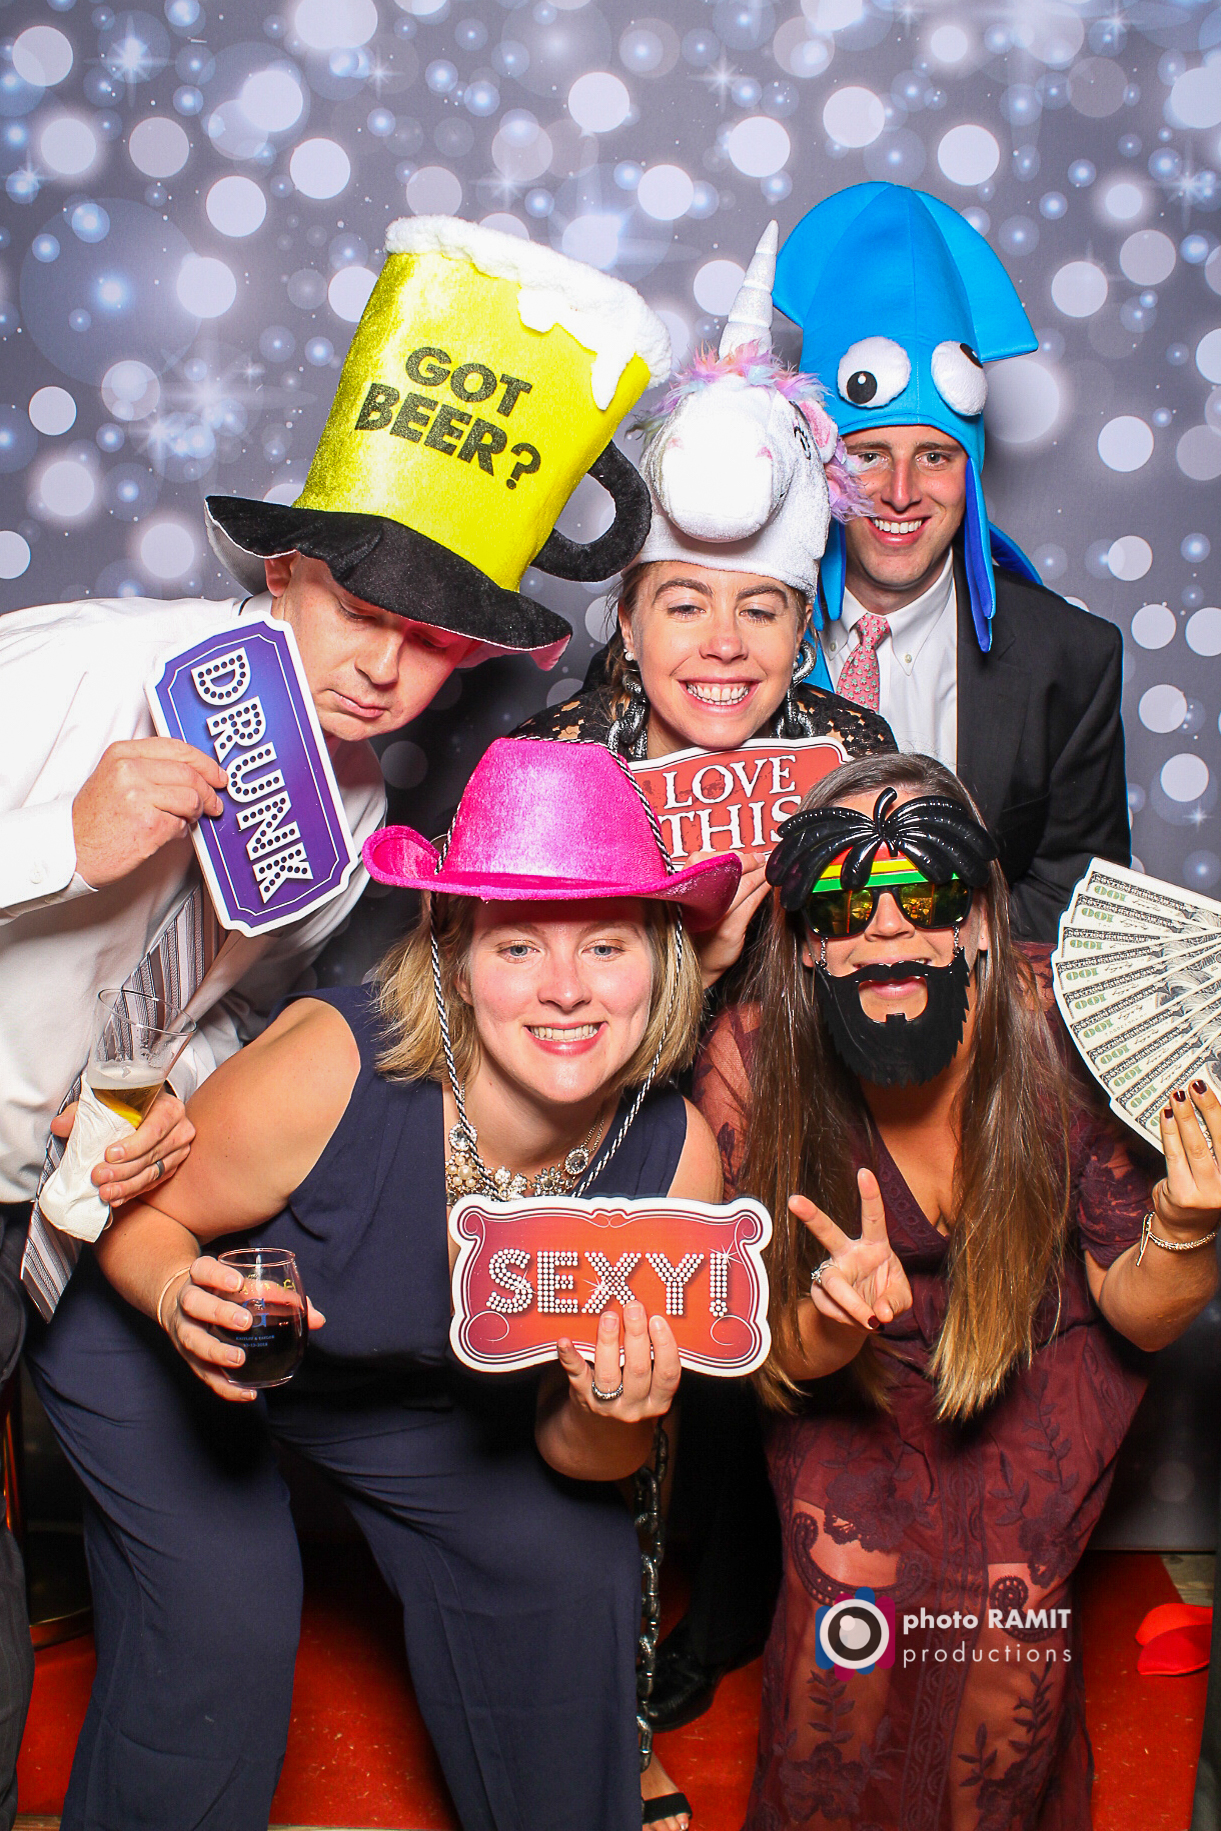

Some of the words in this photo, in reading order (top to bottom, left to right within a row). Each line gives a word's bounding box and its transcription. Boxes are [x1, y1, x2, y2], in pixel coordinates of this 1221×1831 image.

[405, 346, 533, 418] GOT
[354, 382, 542, 490] BEER?
[190, 647, 314, 904] DRUNK
[662, 755, 797, 809] LOVE
[1094, 886, 1127, 902] 100
[1081, 908, 1114, 922] 100
[1069, 939, 1103, 950] 100
[1066, 967, 1098, 980] 100
[1075, 993, 1107, 1009] 100
[1083, 1017, 1114, 1037] 100
[1100, 1043, 1131, 1063] 100
[1114, 1064, 1143, 1086] 100
[1131, 1084, 1158, 1107] 100
[486, 1248, 728, 1317] SEXY!
